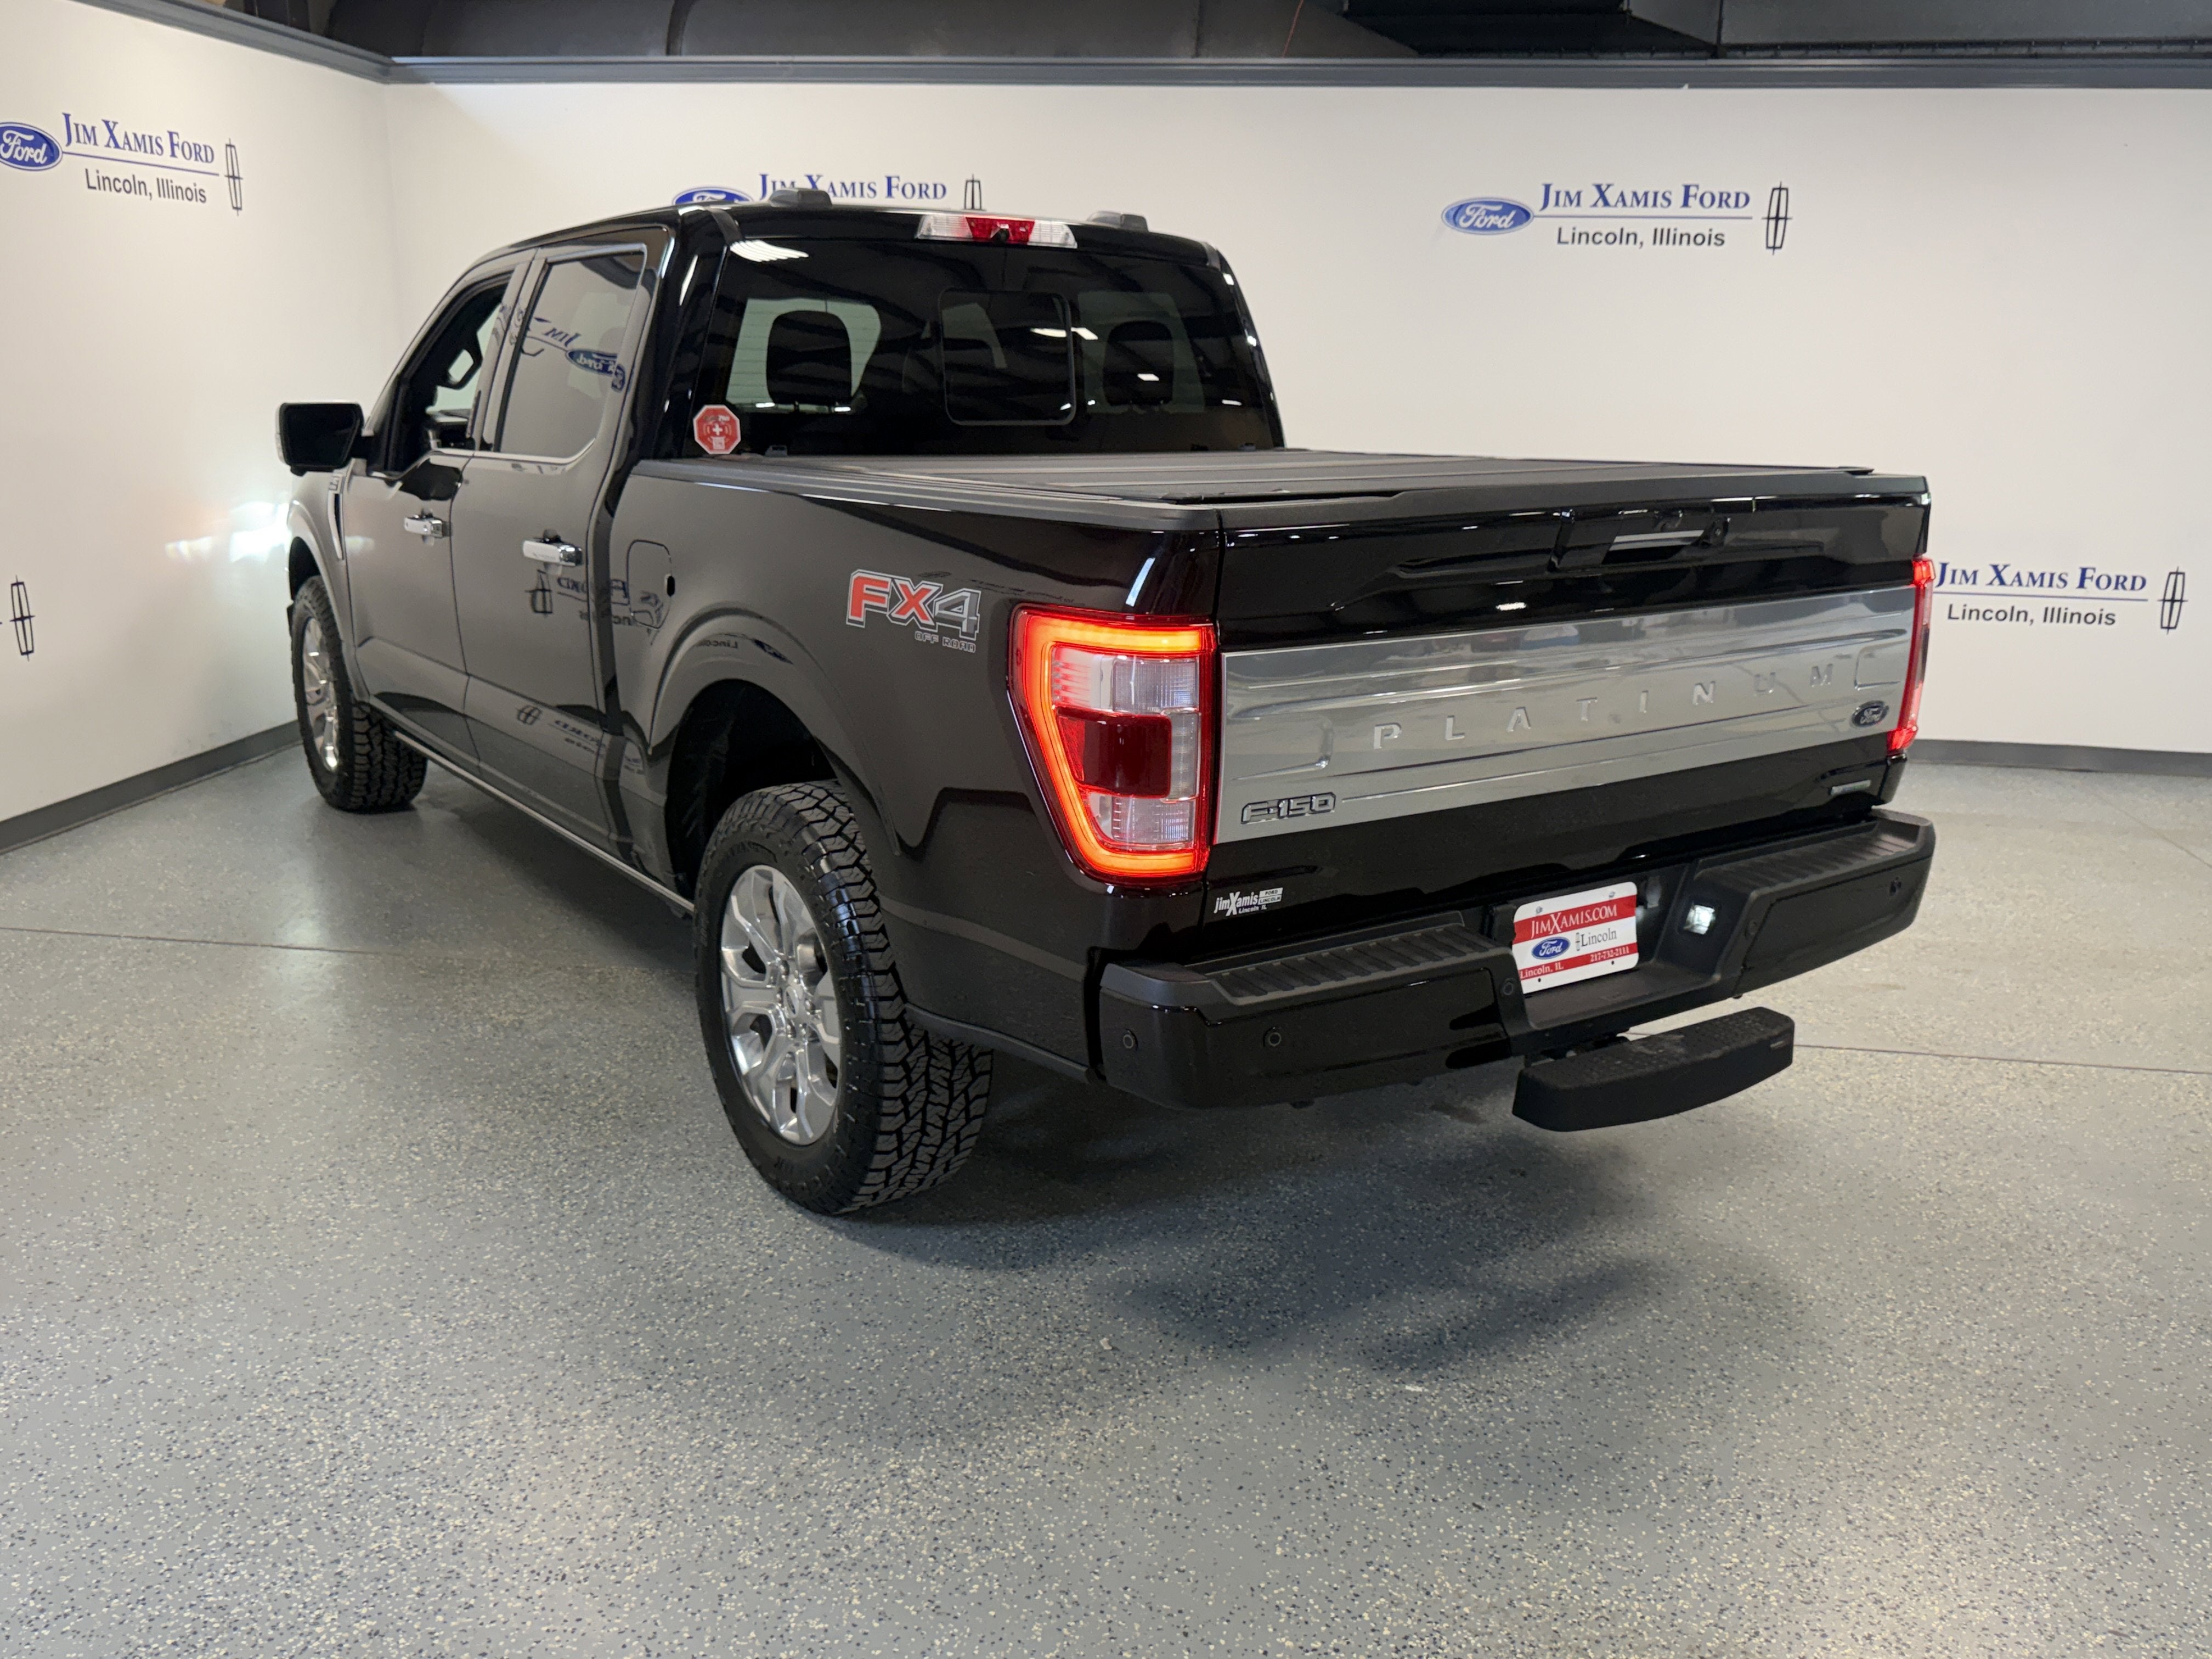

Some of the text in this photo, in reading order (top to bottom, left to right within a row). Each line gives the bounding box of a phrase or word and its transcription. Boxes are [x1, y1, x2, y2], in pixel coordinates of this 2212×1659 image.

[0, 129, 48, 165] Ford
[62, 112, 215, 163] JIM XAMIS FORD
[85, 168, 207, 204] Lincoln, Illinois
[884, 175, 947, 200] FORD
[1539, 183, 1751, 212] JIM XAMIS FORD
[1458, 204, 1515, 230] Ford
[1556, 227, 1726, 250] Lincoln, Illinois
[1934, 562, 2147, 591] JIM XAMIS FORD
[846, 569, 981, 641] FX4
[1948, 604, 2116, 626] Lincoln, Illinois
[915, 631, 976, 653] OFF ROAD
[1373, 663, 1833, 749] PLATINUM
[1241, 792, 1336, 824] F-150
[1539, 939, 1563, 956] Ford
[1581, 928, 1617, 947] Lincoln
[1555, 962, 1564, 970] IL
[1590, 946, 1629, 962] 217-732-2111
